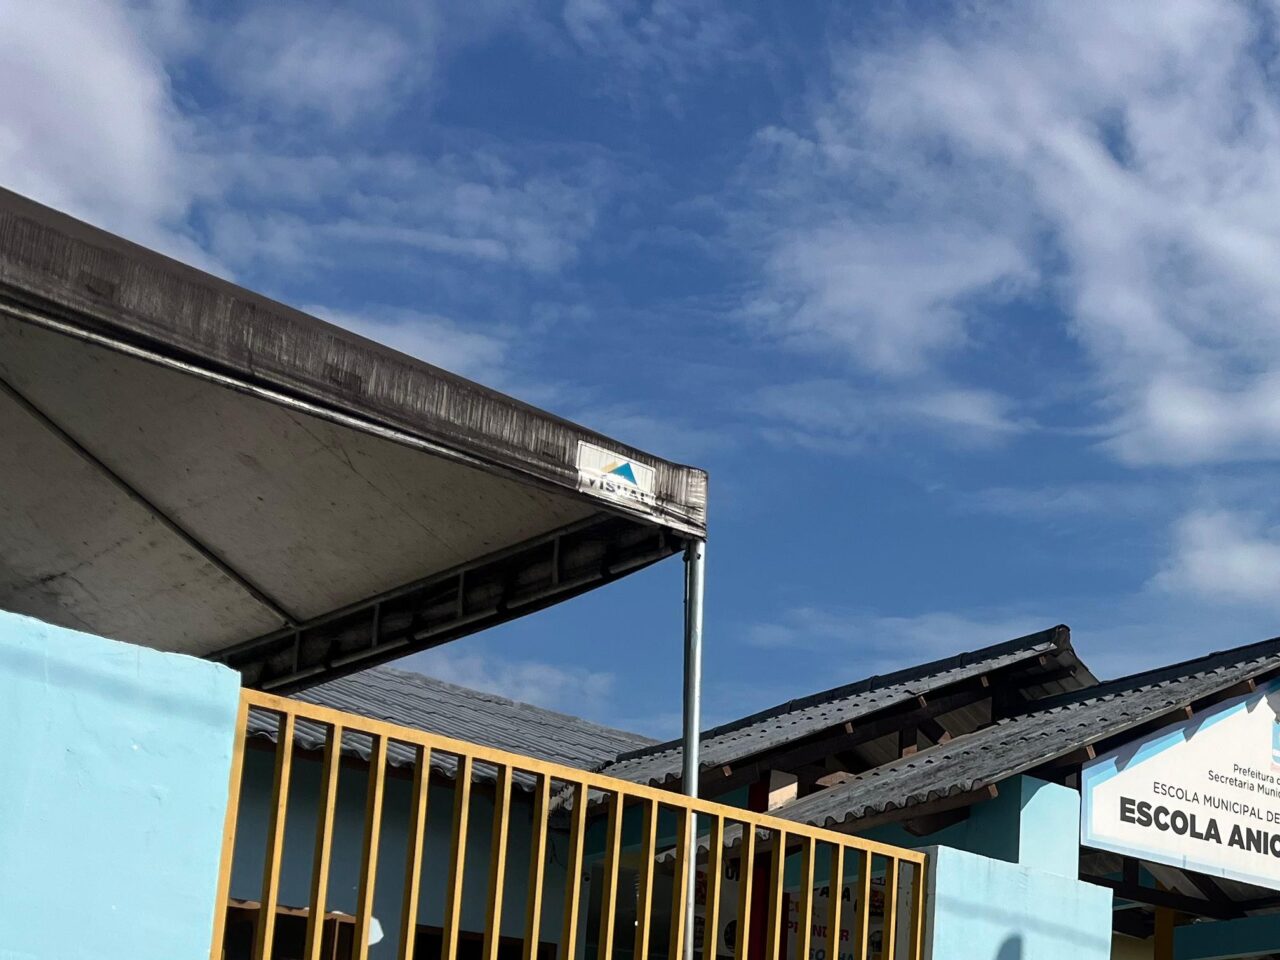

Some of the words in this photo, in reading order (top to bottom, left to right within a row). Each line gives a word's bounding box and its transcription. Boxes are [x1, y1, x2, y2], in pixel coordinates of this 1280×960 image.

[1208, 769, 1255, 792] Secretaria
[1233, 764, 1275, 784] Prefeitura
[1153, 781, 1200, 804] ESCOLA
[1203, 794, 1264, 820] MUNICIPAL
[1266, 810, 1280, 825] DE
[1119, 796, 1222, 844] ESCOLA
